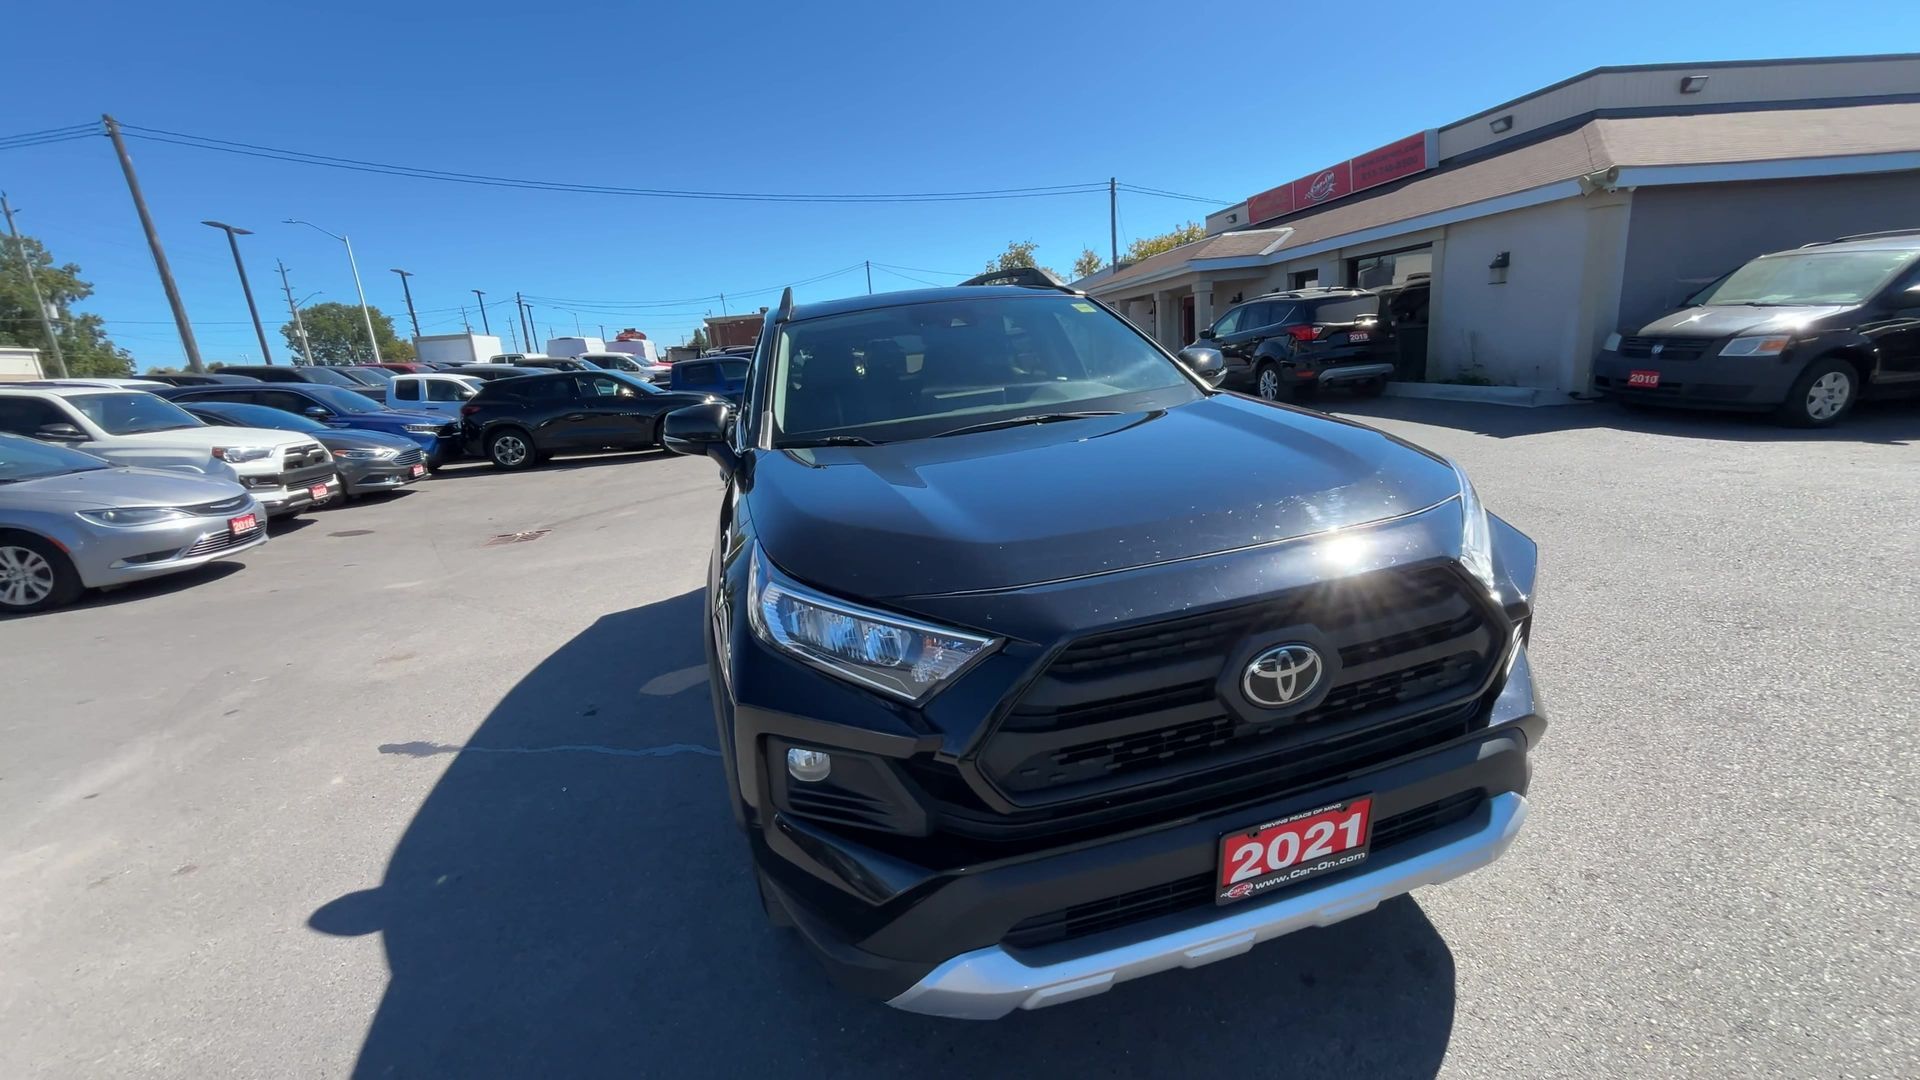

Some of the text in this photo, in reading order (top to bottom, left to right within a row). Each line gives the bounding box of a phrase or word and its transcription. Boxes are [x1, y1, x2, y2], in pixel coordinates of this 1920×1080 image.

[1260, 819, 1289, 830] DRIVING
[1289, 811, 1312, 822] PEACE
[1323, 803, 1342, 812] MIND
[1230, 812, 1361, 884] 2021
[1255, 852, 1365, 889] www.Car-On.com
